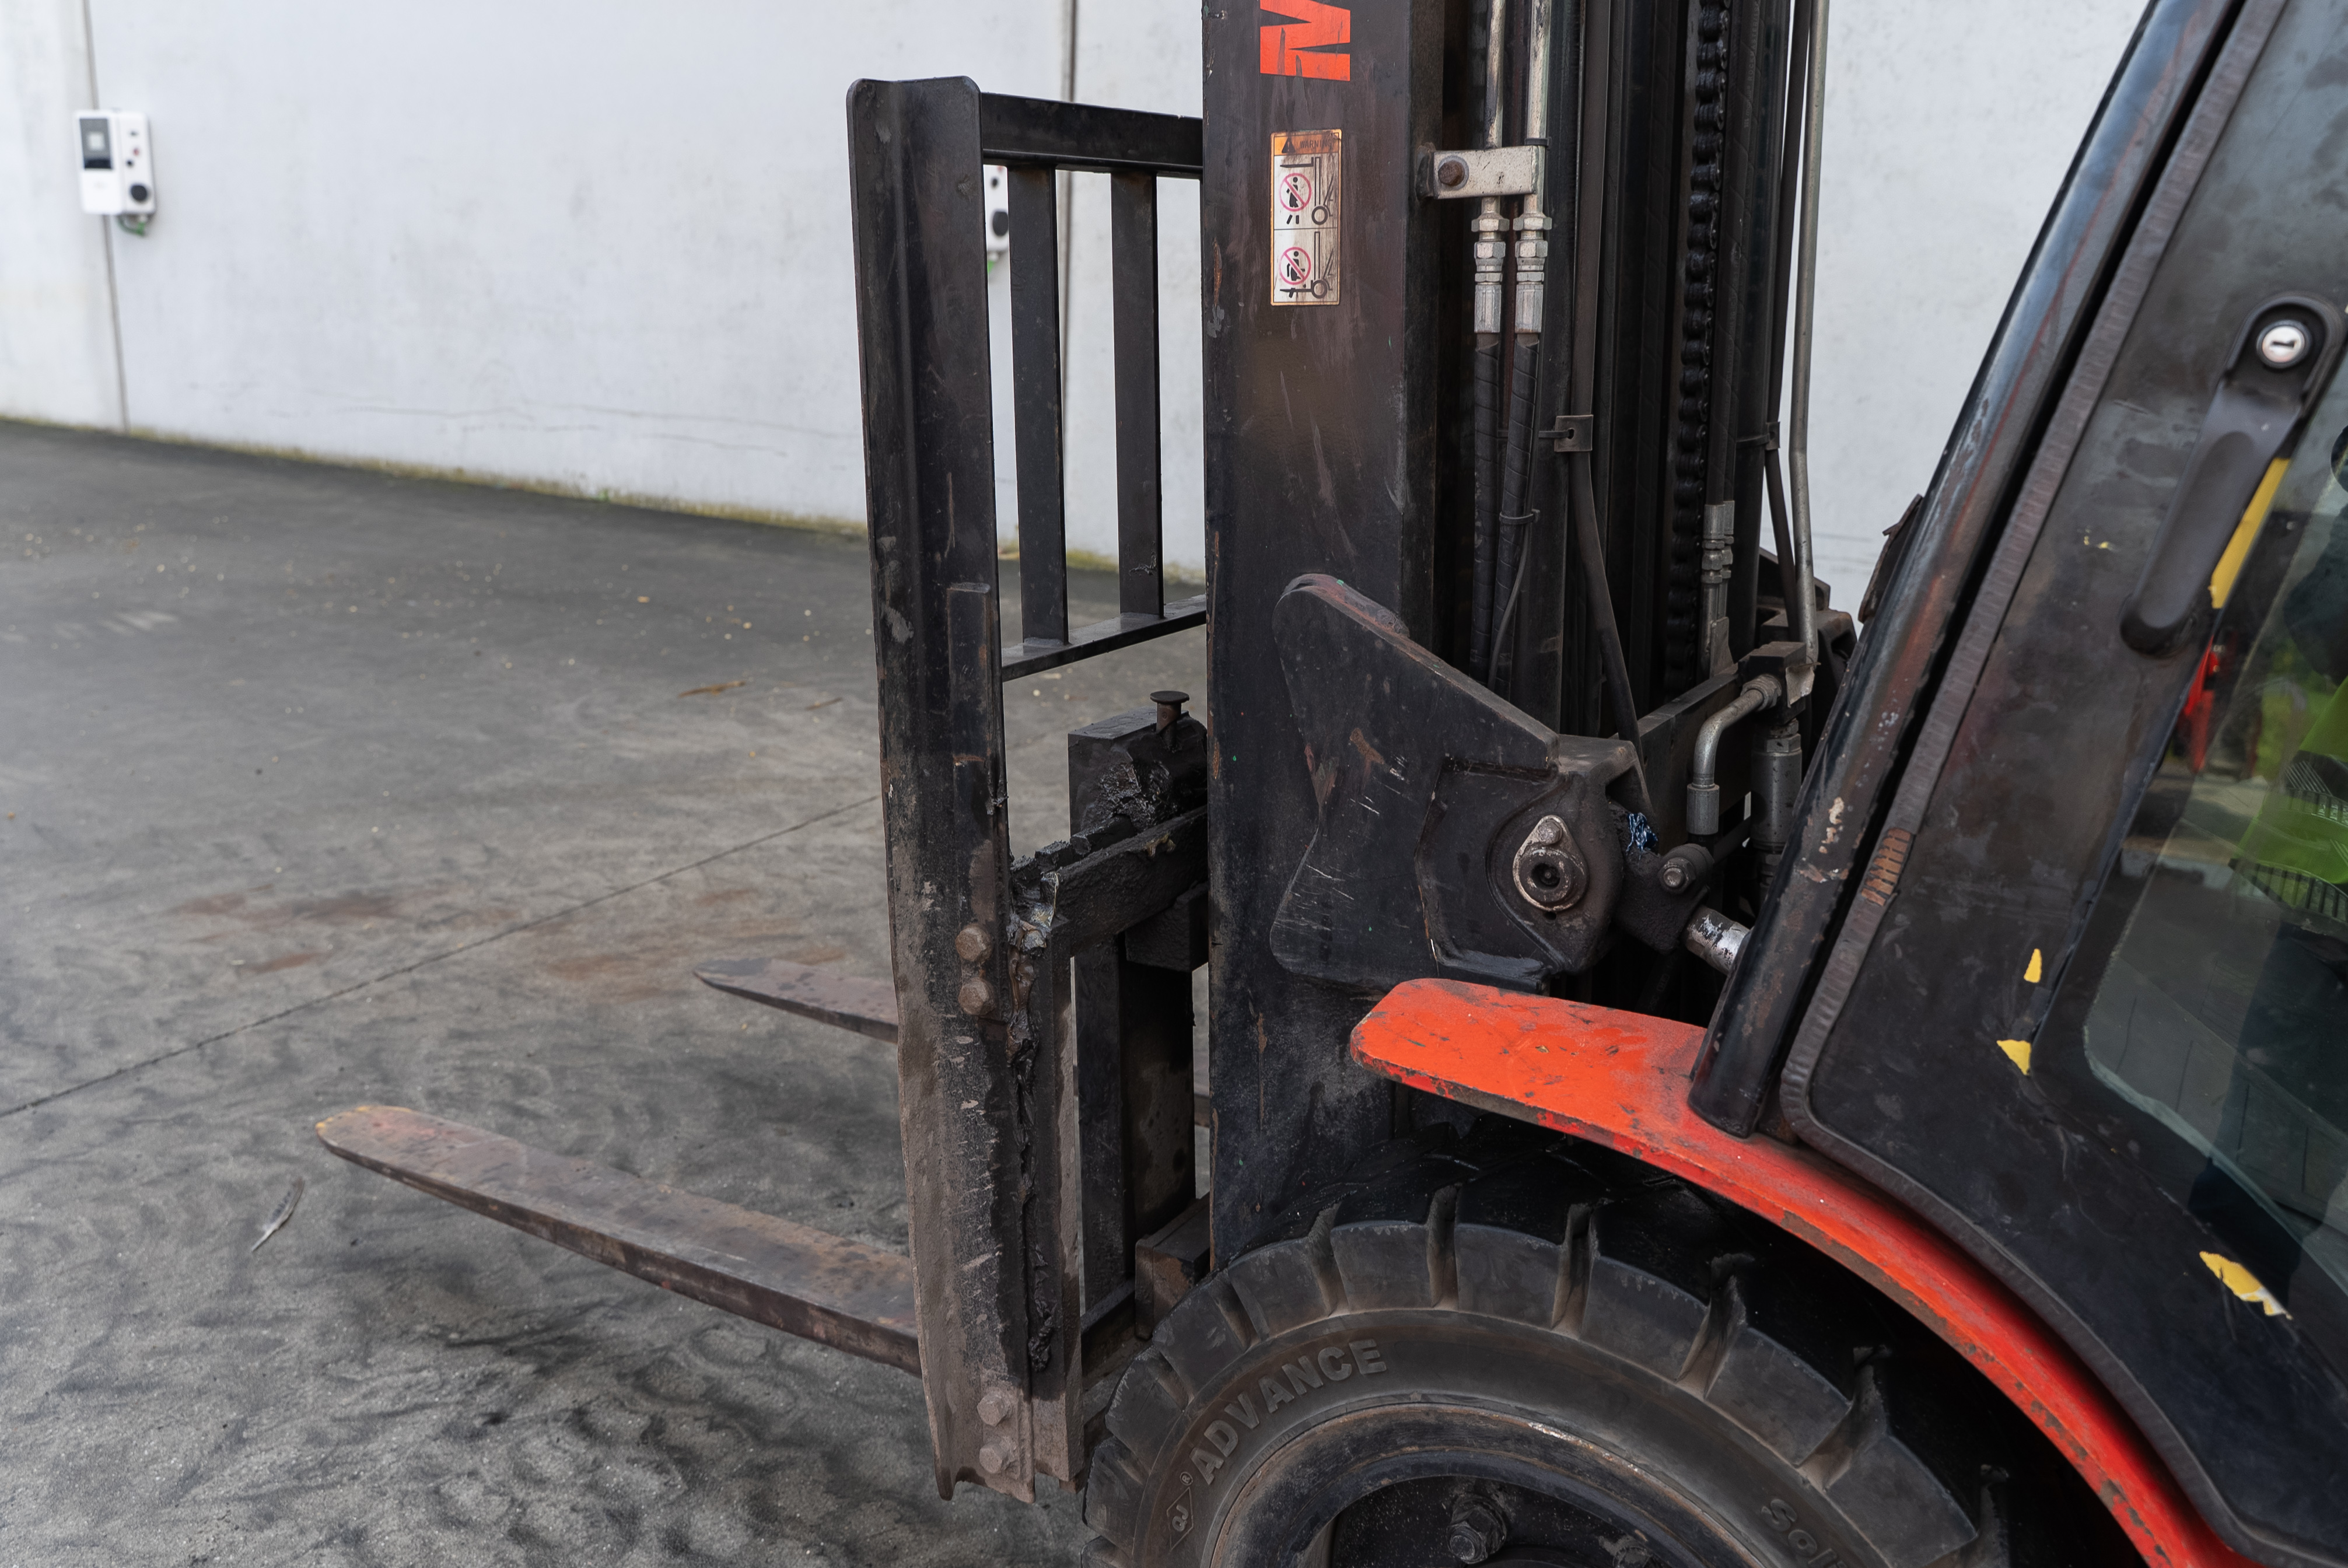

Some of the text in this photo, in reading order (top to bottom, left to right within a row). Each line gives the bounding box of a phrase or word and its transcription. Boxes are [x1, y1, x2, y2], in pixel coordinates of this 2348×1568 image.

[1299, 139, 1333, 149] WARNING
[1189, 1339, 1387, 1486] ADVANCE
[1171, 1503, 1189, 1532] QJ
